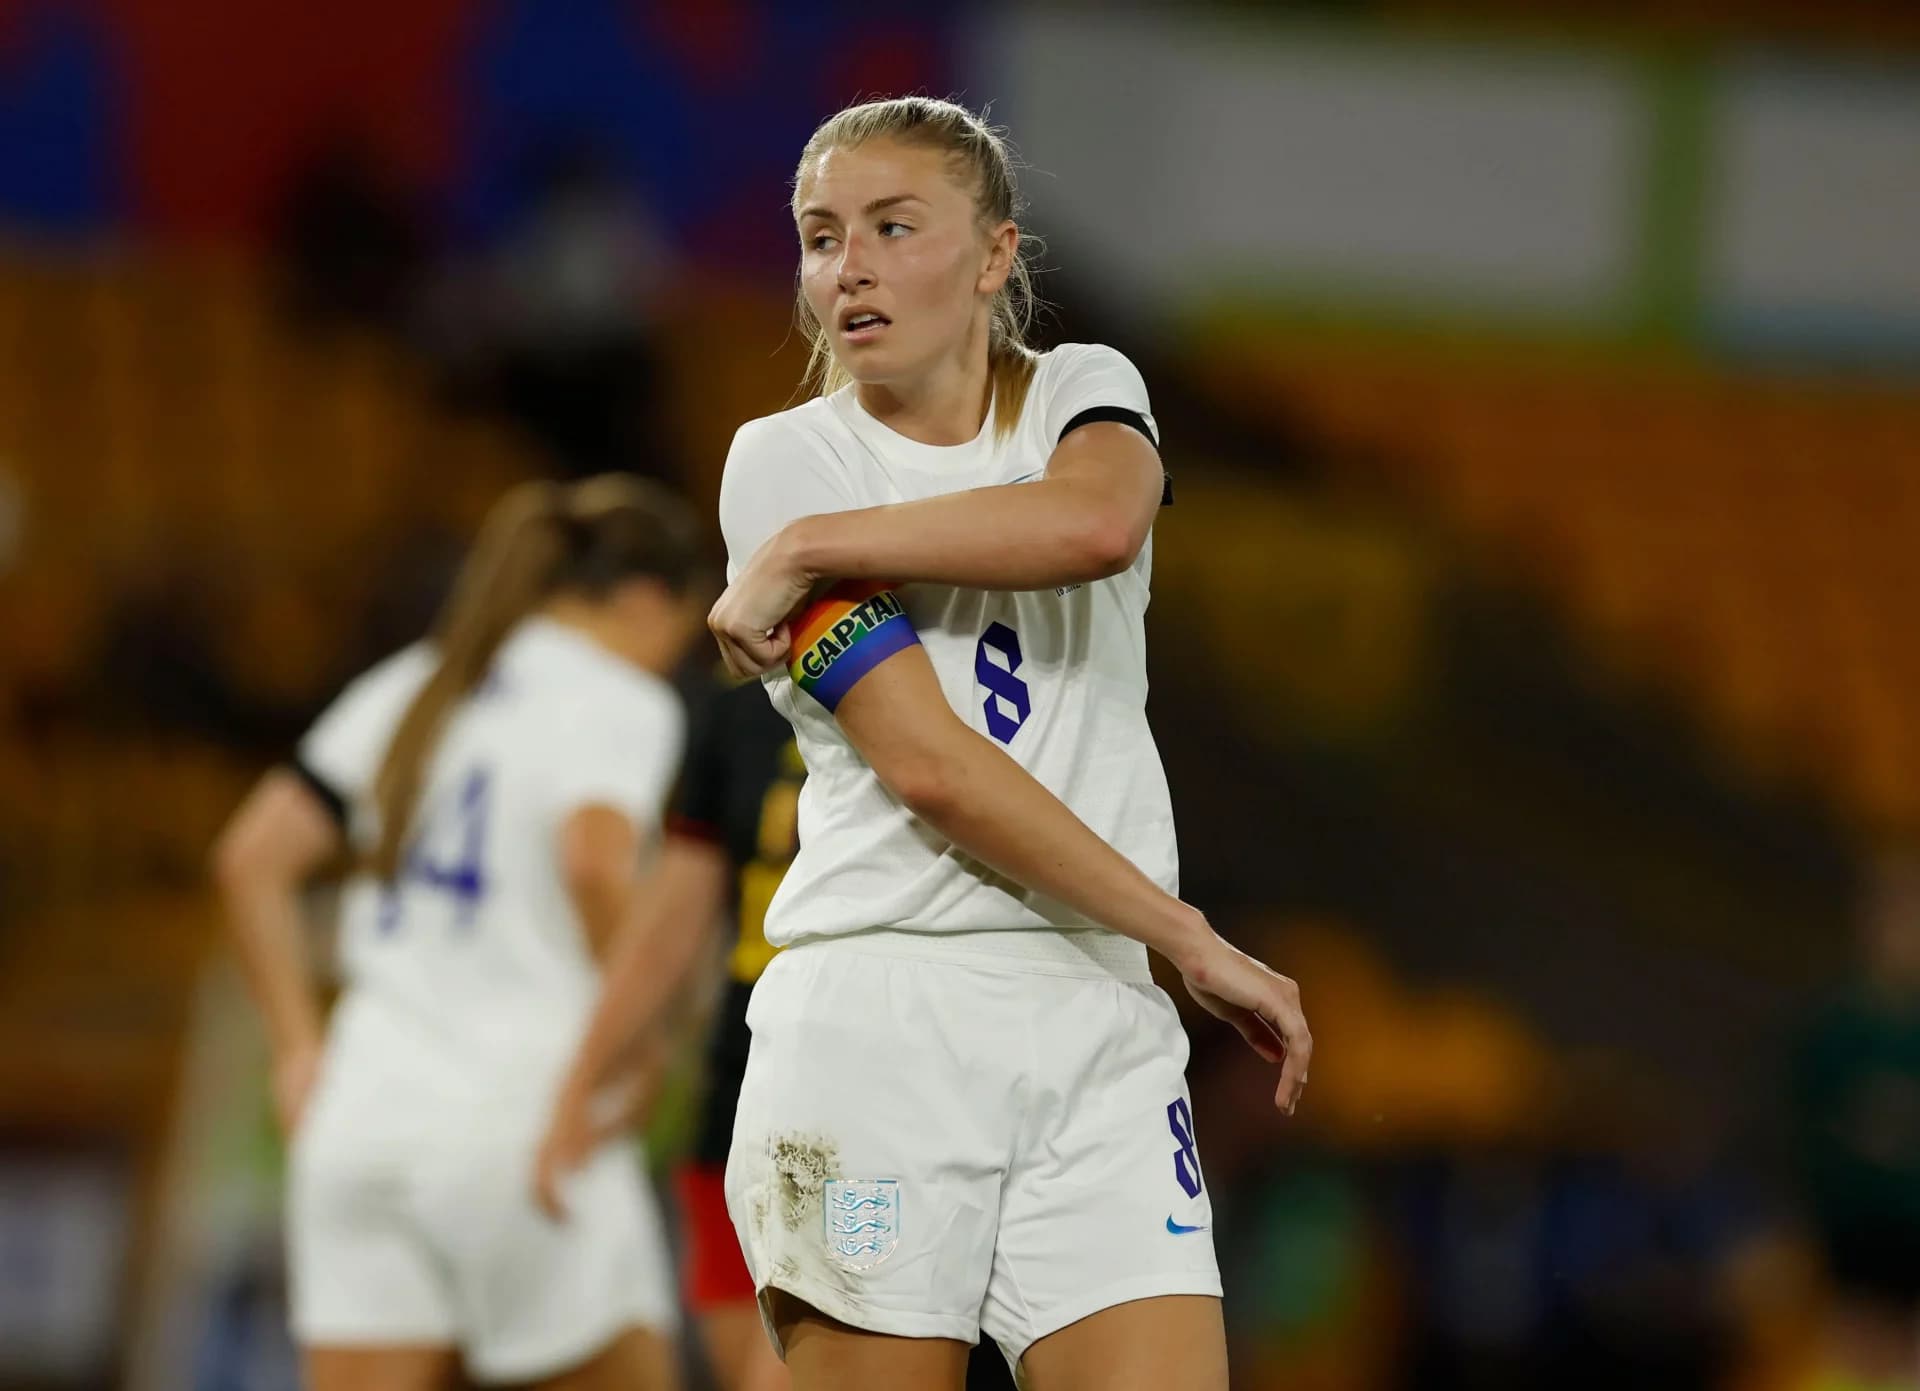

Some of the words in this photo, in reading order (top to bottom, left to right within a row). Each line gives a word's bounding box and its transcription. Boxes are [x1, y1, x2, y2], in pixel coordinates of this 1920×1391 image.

[802, 591, 905, 679] CAPTAI
[975, 621, 1031, 744] 8
[1167, 1096, 1202, 1199] 8
